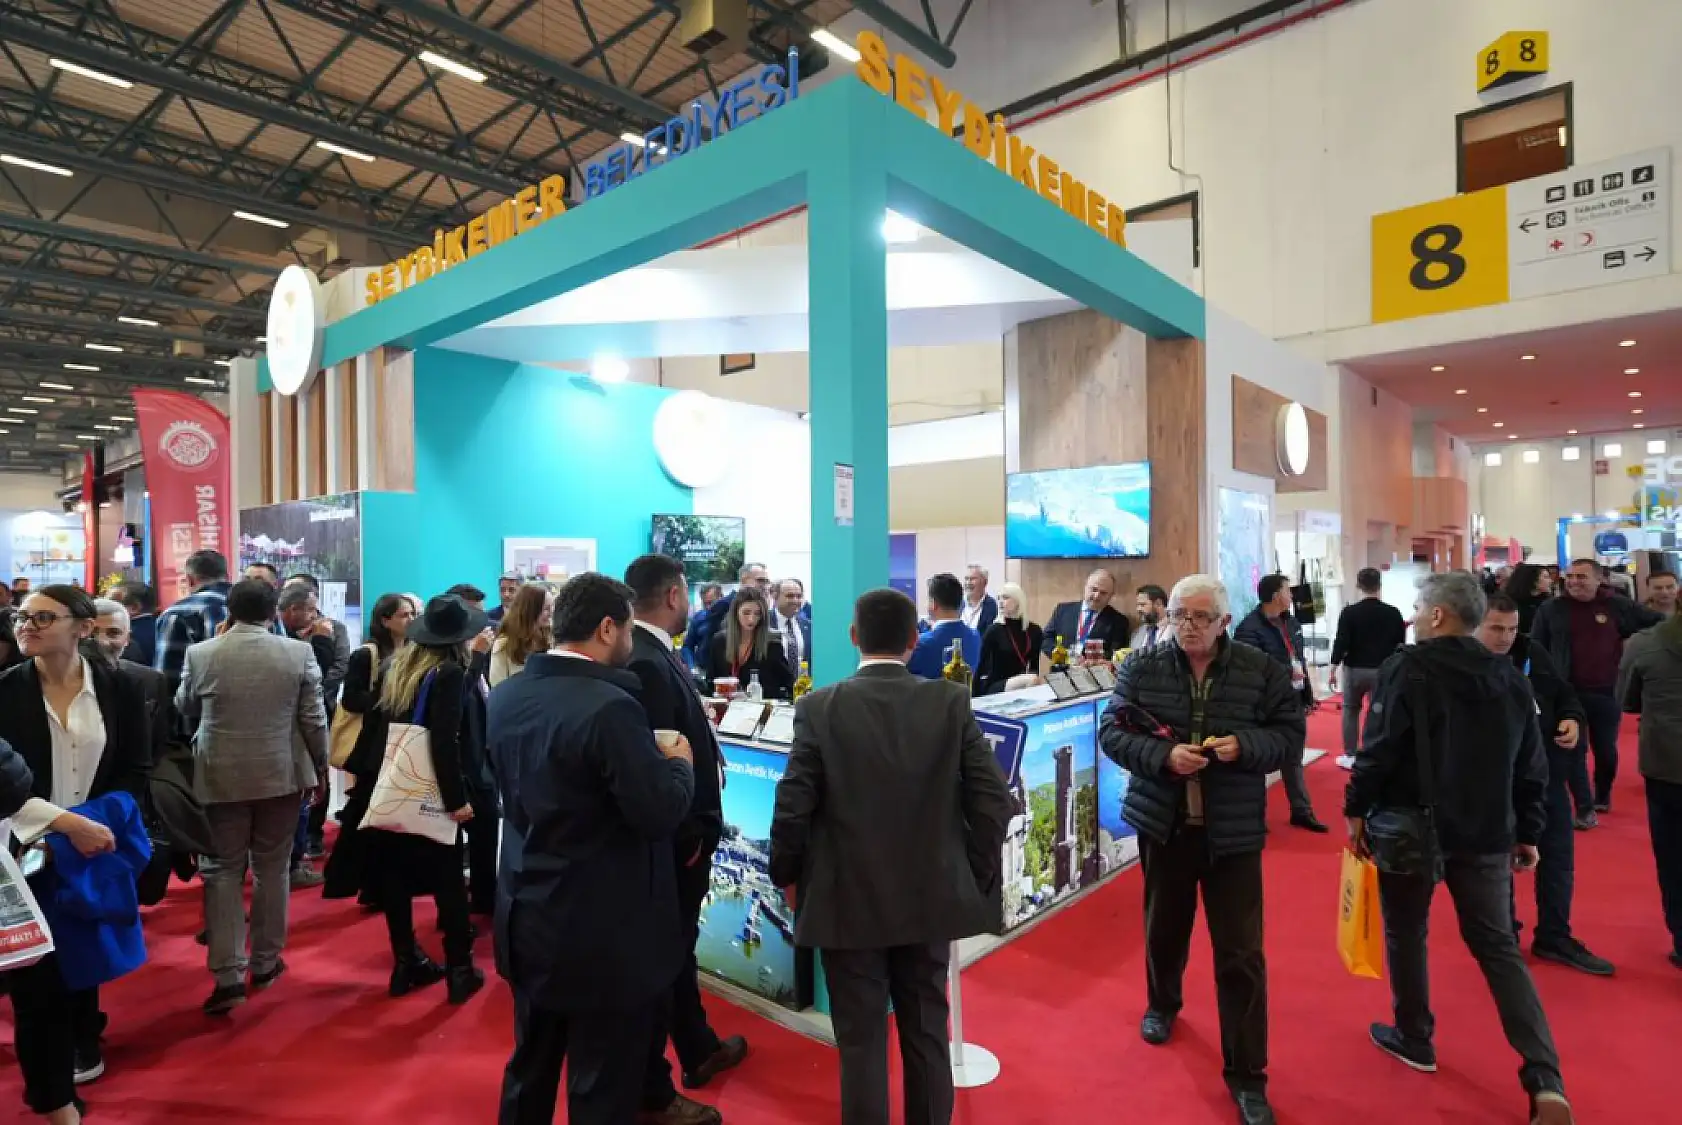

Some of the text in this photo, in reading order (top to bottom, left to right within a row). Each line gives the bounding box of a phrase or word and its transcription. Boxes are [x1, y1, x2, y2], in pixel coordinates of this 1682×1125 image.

[1485, 38, 1537, 77] 8 8
[364, 45, 799, 305] SEYDİKEMER BELEDİYESİ
[856, 31, 1127, 249] SEYDİKEMER
[1409, 223, 1467, 291] 8
